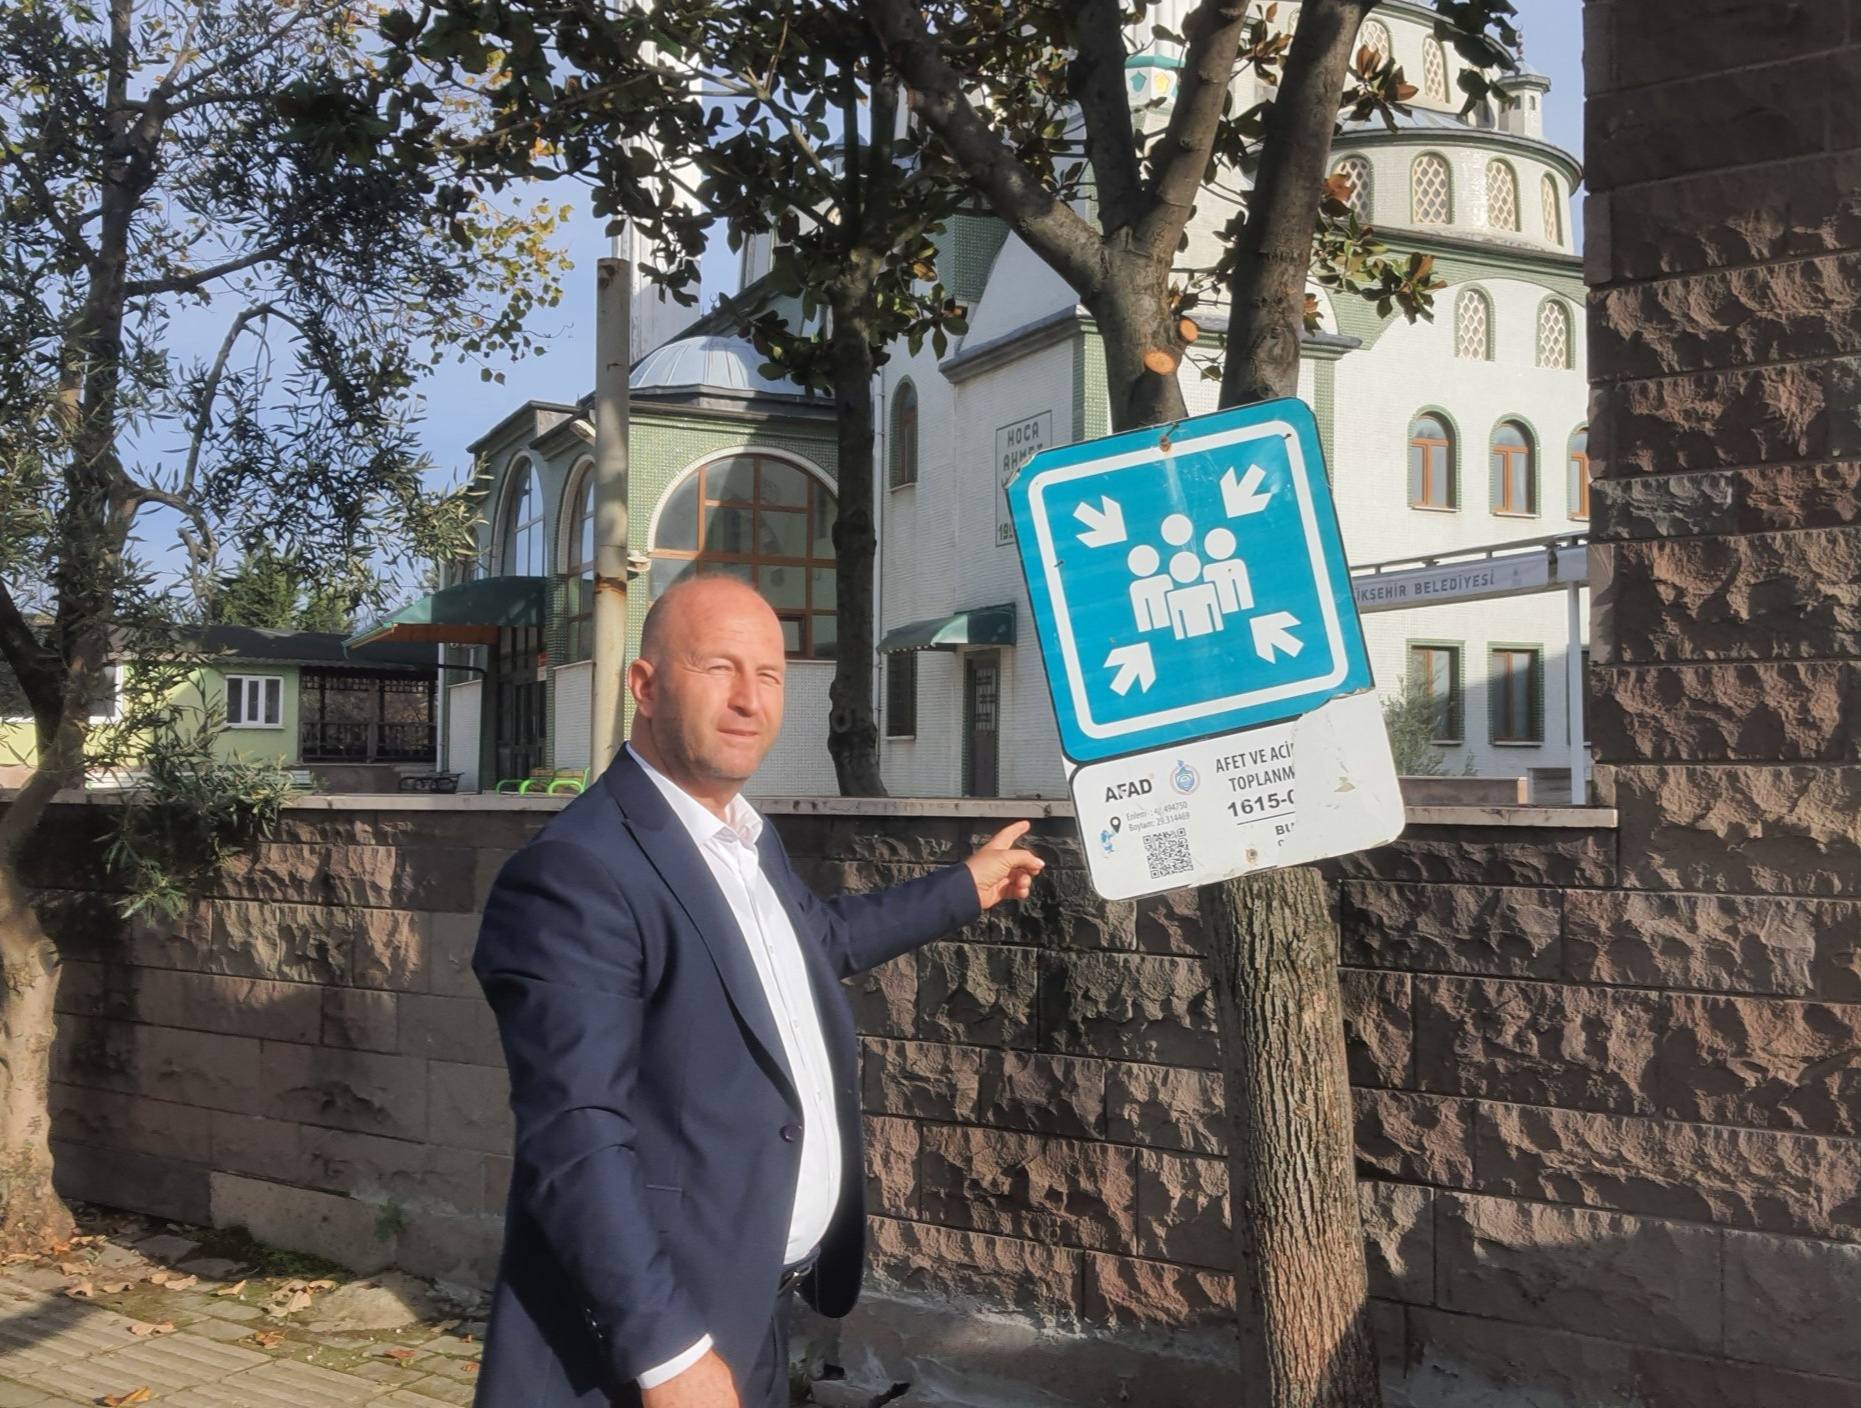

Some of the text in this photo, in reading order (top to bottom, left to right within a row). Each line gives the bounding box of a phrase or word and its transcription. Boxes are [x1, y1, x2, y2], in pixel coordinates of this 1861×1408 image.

[1008, 421, 1039, 447] HOCA
[1415, 570, 1495, 595] BELEDİYESİ
[1216, 753, 1246, 773] AFET
[1249, 749, 1267, 765] VE
[1105, 778, 1153, 803] AFAD
[1228, 766, 1295, 792] TOPLANM
